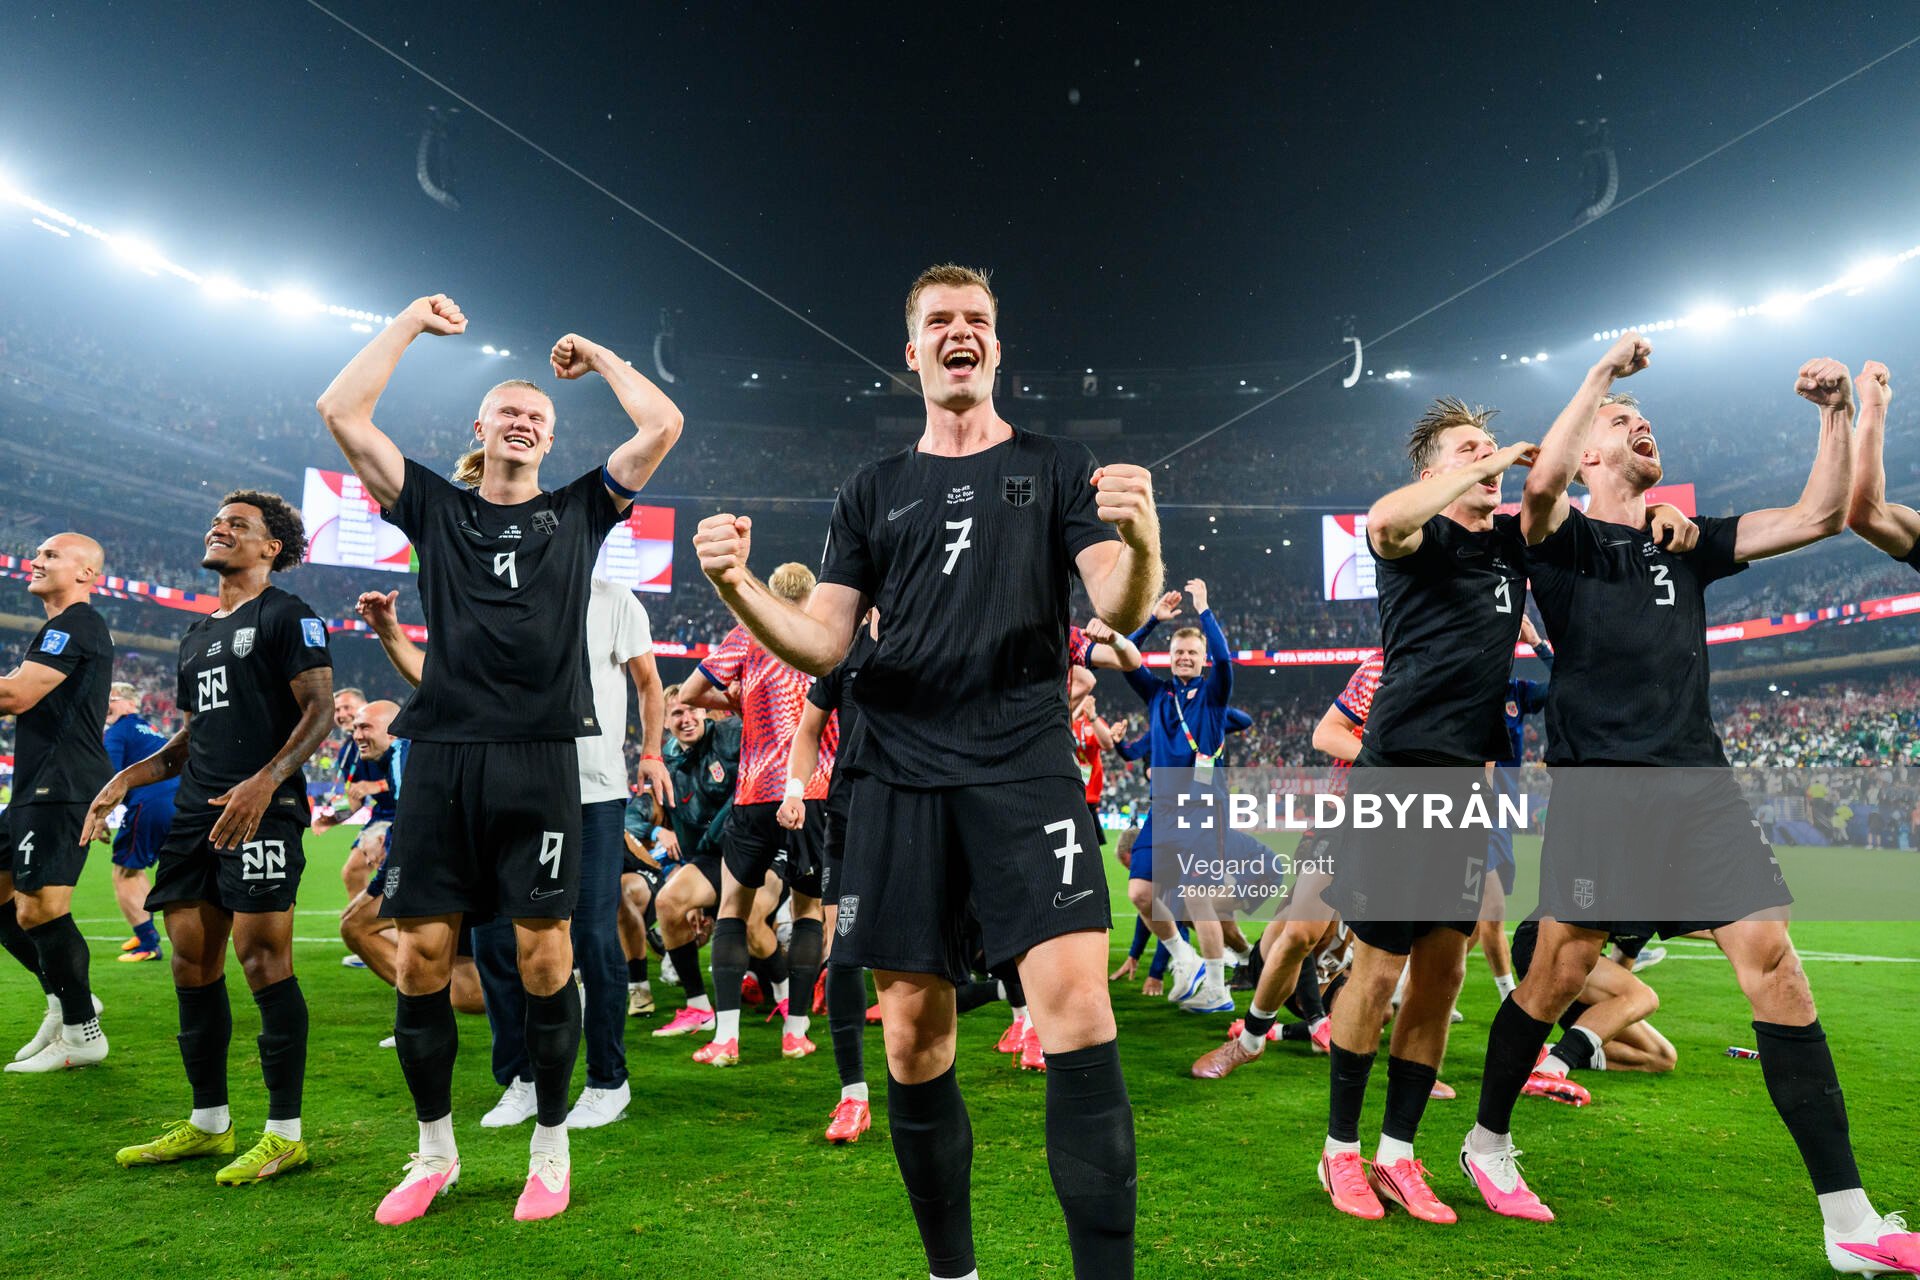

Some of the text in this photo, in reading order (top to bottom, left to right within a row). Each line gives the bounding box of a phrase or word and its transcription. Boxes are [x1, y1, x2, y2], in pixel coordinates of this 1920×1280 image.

[942, 517, 972, 575] 7
[493, 551, 518, 588] 9
[1650, 564, 1676, 606] 3
[1273, 652, 1297, 662] FIFA
[1297, 651, 1336, 662] WORLD
[1335, 650, 1357, 661] CUP
[197, 665, 229, 713] 22
[18, 830, 35, 865] 4
[242, 840, 286, 880] 22
[538, 831, 563, 878] 9
[1043, 818, 1083, 885] 7
